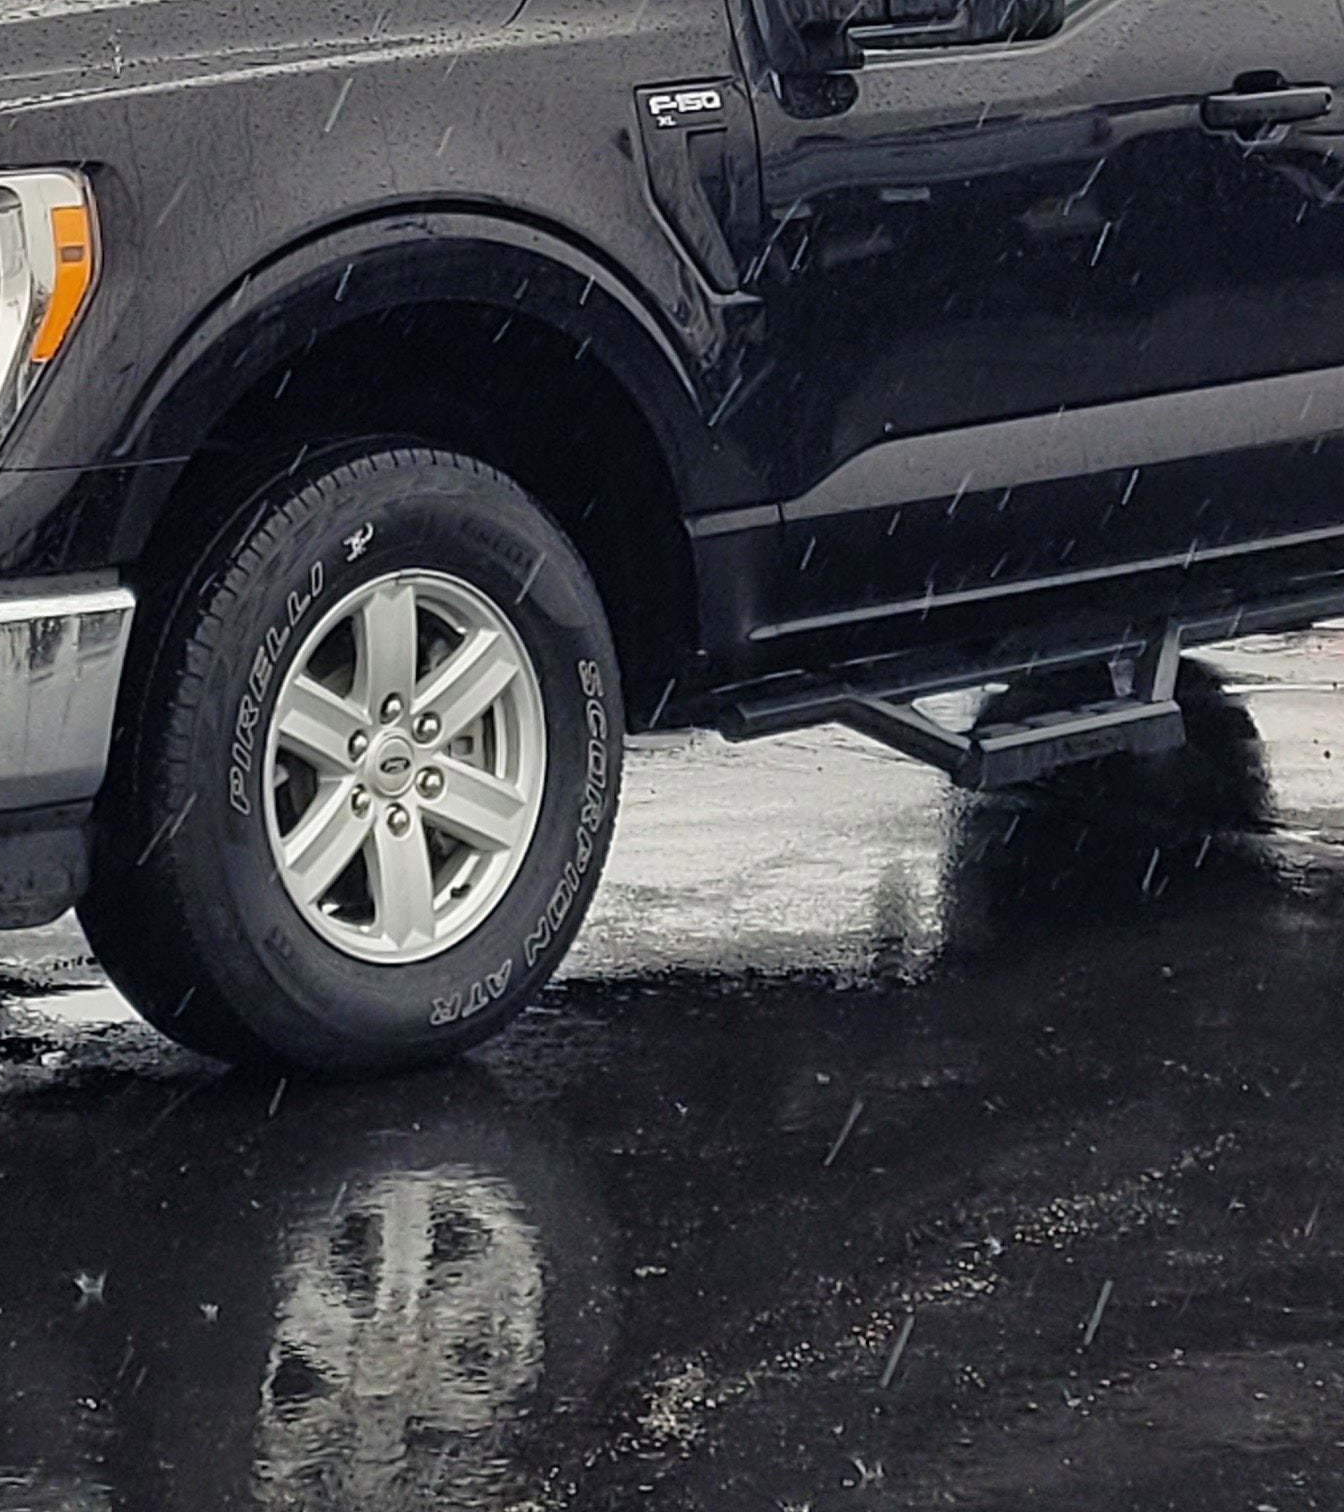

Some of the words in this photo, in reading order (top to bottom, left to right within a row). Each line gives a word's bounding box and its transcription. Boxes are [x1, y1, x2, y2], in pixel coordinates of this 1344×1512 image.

[648, 90, 722, 116] F-150
[656, 115, 678, 128] XL
[229, 560, 325, 816] PIRELLI
[523, 658, 609, 968] SCORPION
[429, 958, 513, 1027] ATR
